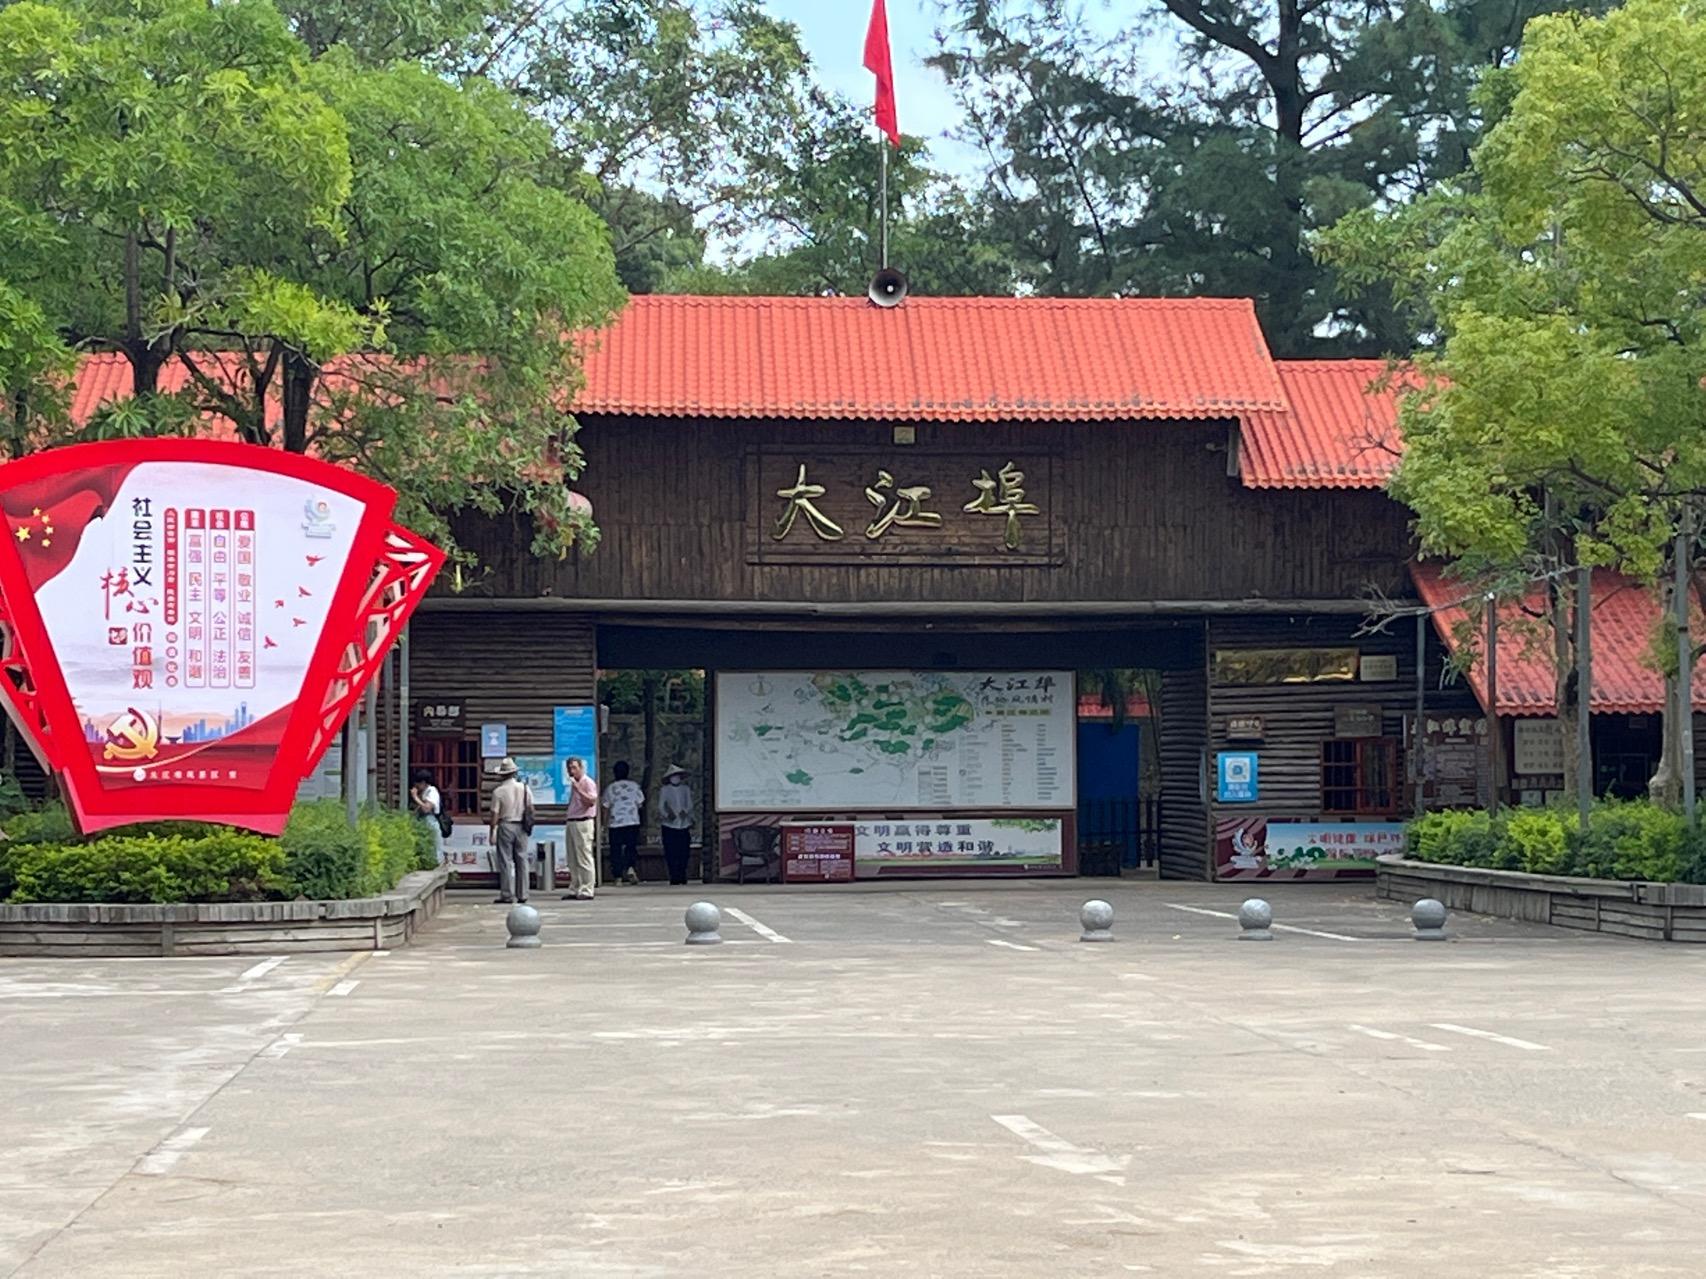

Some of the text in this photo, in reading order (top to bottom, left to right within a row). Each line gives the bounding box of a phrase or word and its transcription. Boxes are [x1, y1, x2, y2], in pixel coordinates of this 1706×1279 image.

[769, 461, 1041, 549] 大江埠
[213, 534, 227, 564] 自由
[100, 567, 159, 621] 核心
[132, 497, 153, 690] 社会主义 价值观
[189, 571, 202, 602] 民主
[189, 611, 202, 641] 文明
[213, 610, 227, 641] 公正
[213, 649, 227, 680] 法治
[980, 676, 1056, 693] 大江埠
[855, 824, 972, 837] 文明赢得尊重
